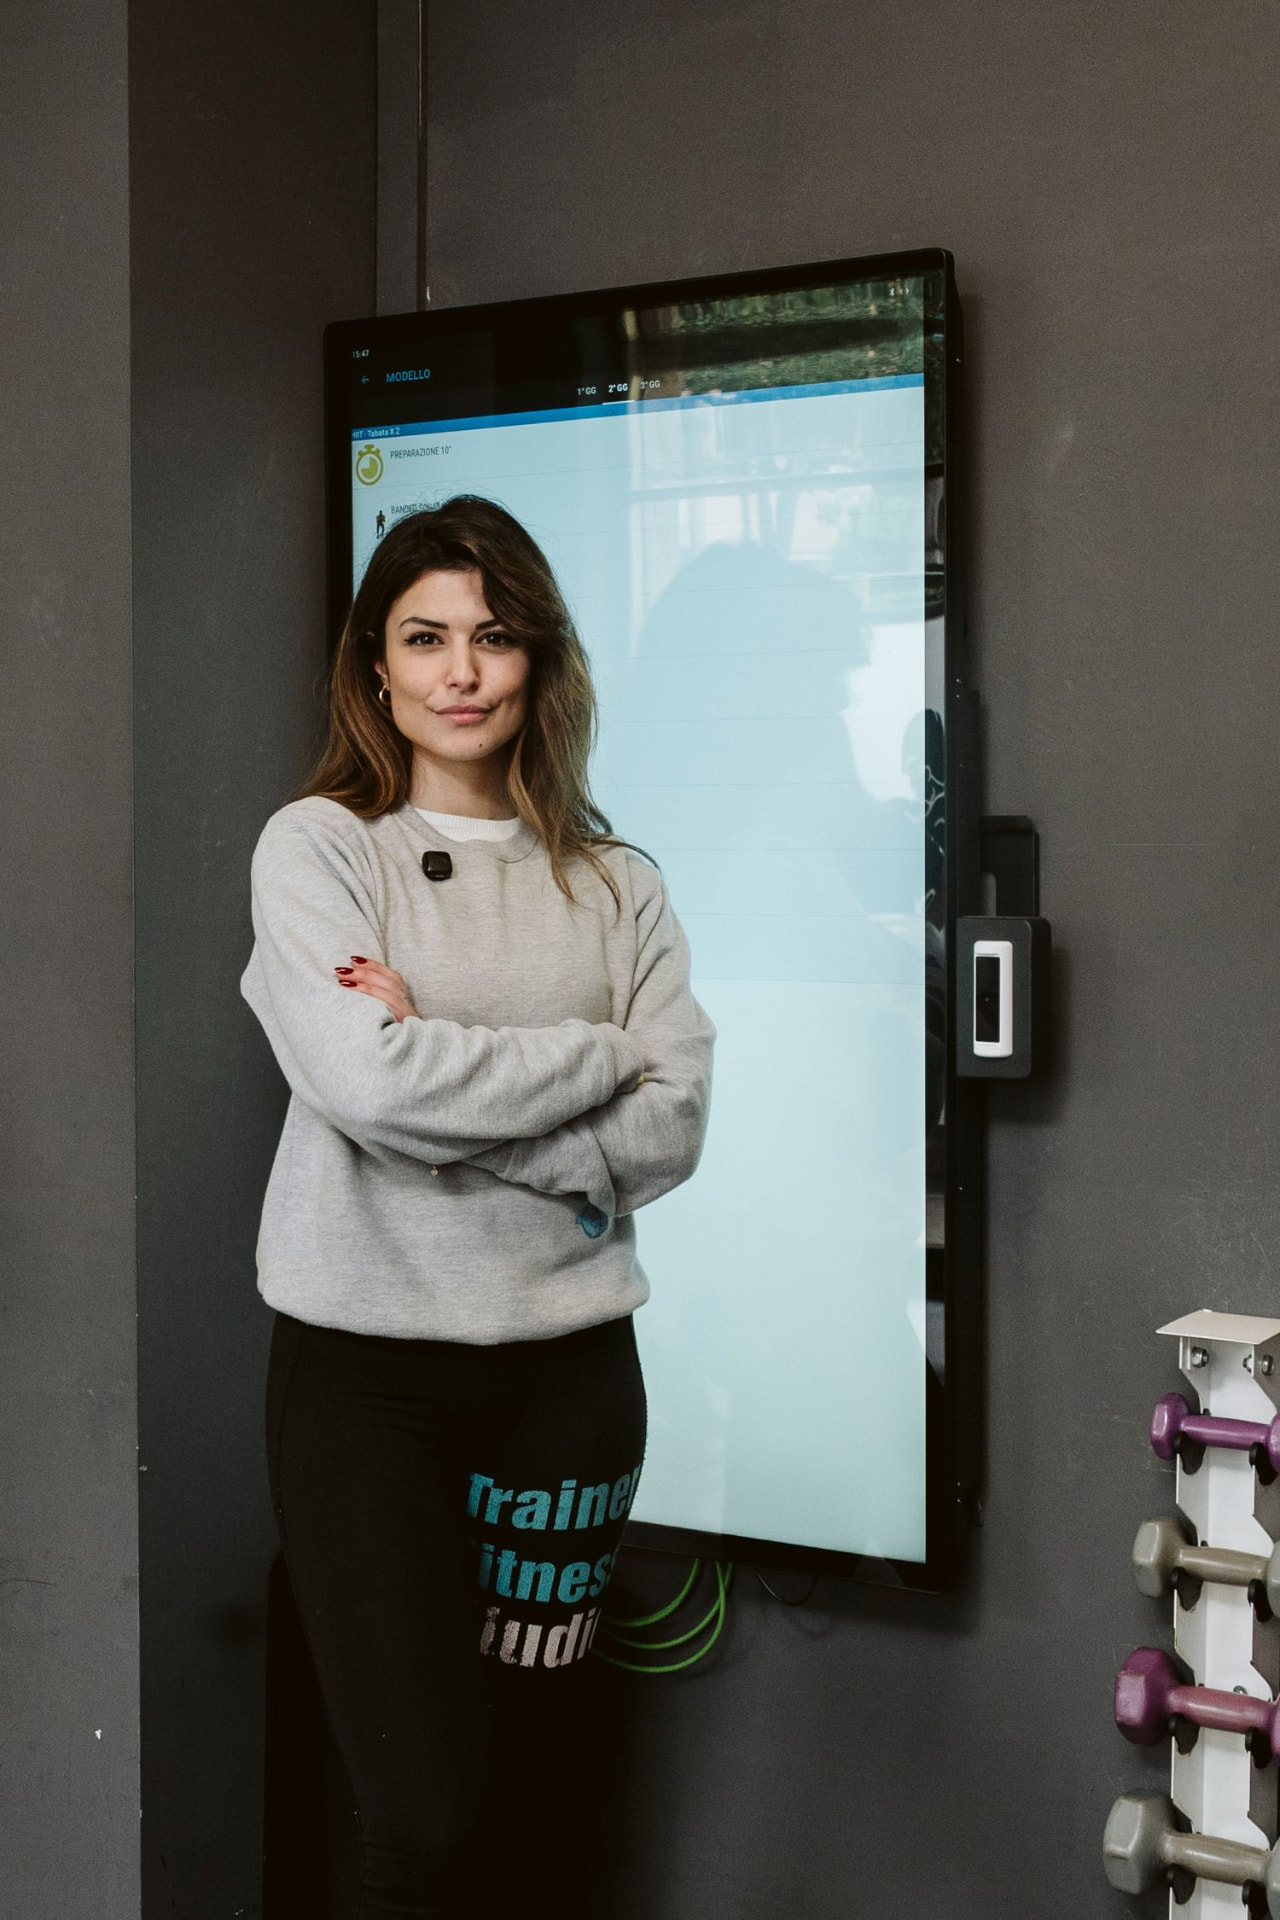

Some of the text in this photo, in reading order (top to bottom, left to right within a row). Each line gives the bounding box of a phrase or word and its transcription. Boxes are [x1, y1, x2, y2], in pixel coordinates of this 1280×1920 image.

[352, 349, 370, 358] 15:47
[385, 368, 431, 383] MODELLO
[367, 429, 389, 438] Tabata
[395, 427, 400, 435] 2
[390, 446, 439, 459] PREPARAZIONE
